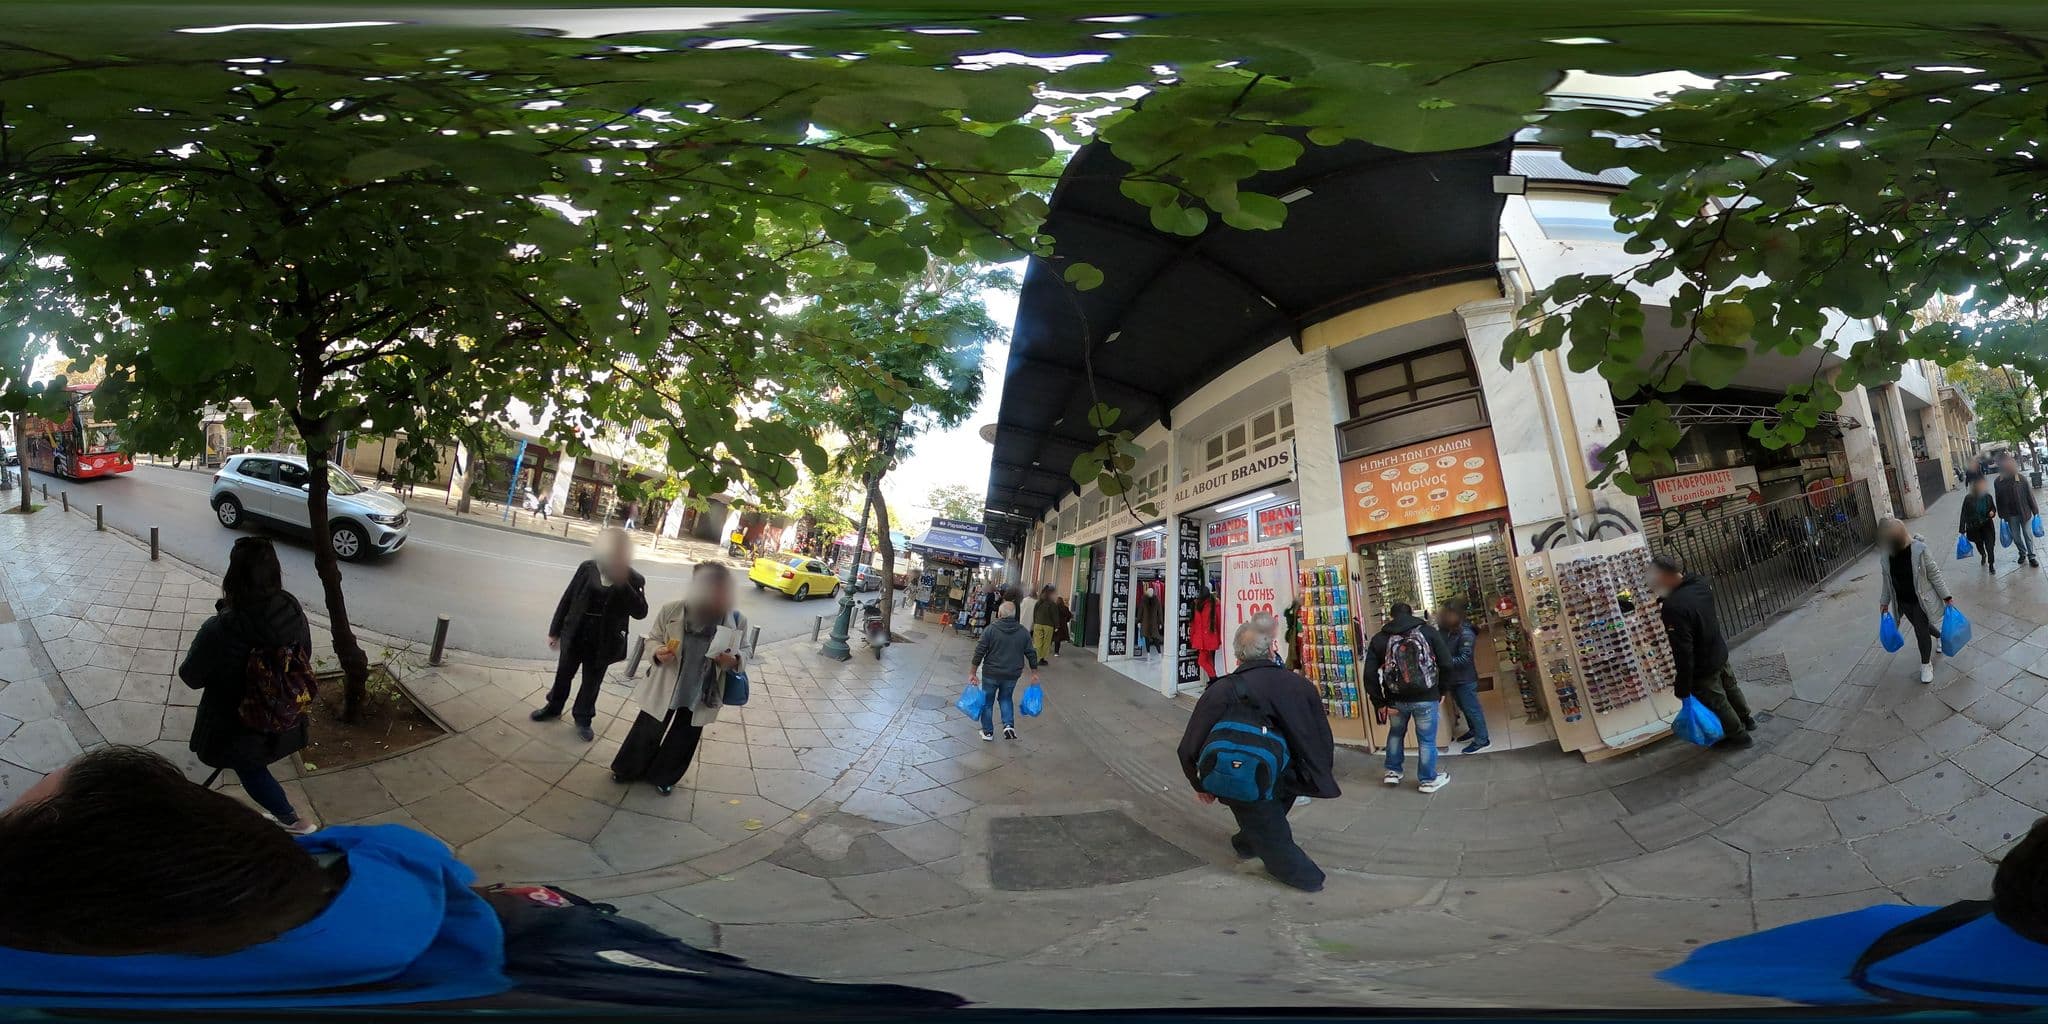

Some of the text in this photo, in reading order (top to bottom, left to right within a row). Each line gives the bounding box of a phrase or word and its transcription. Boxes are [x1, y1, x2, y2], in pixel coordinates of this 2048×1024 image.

[1360, 438, 1471, 472] Η ΠΗΓΗ ΤΩΝ ΓΥΑΛΙΩΝ
[1174, 451, 1289, 503] ALL ABOUT BRANDS
[1391, 473, 1447, 493] Μαρίνος
[1671, 488, 1715, 503] Ευριπίδου
[1250, 557, 1278, 569] SATURDAY
[1249, 572, 1263, 585] ALL
[1237, 588, 1275, 600] CLOTHES
